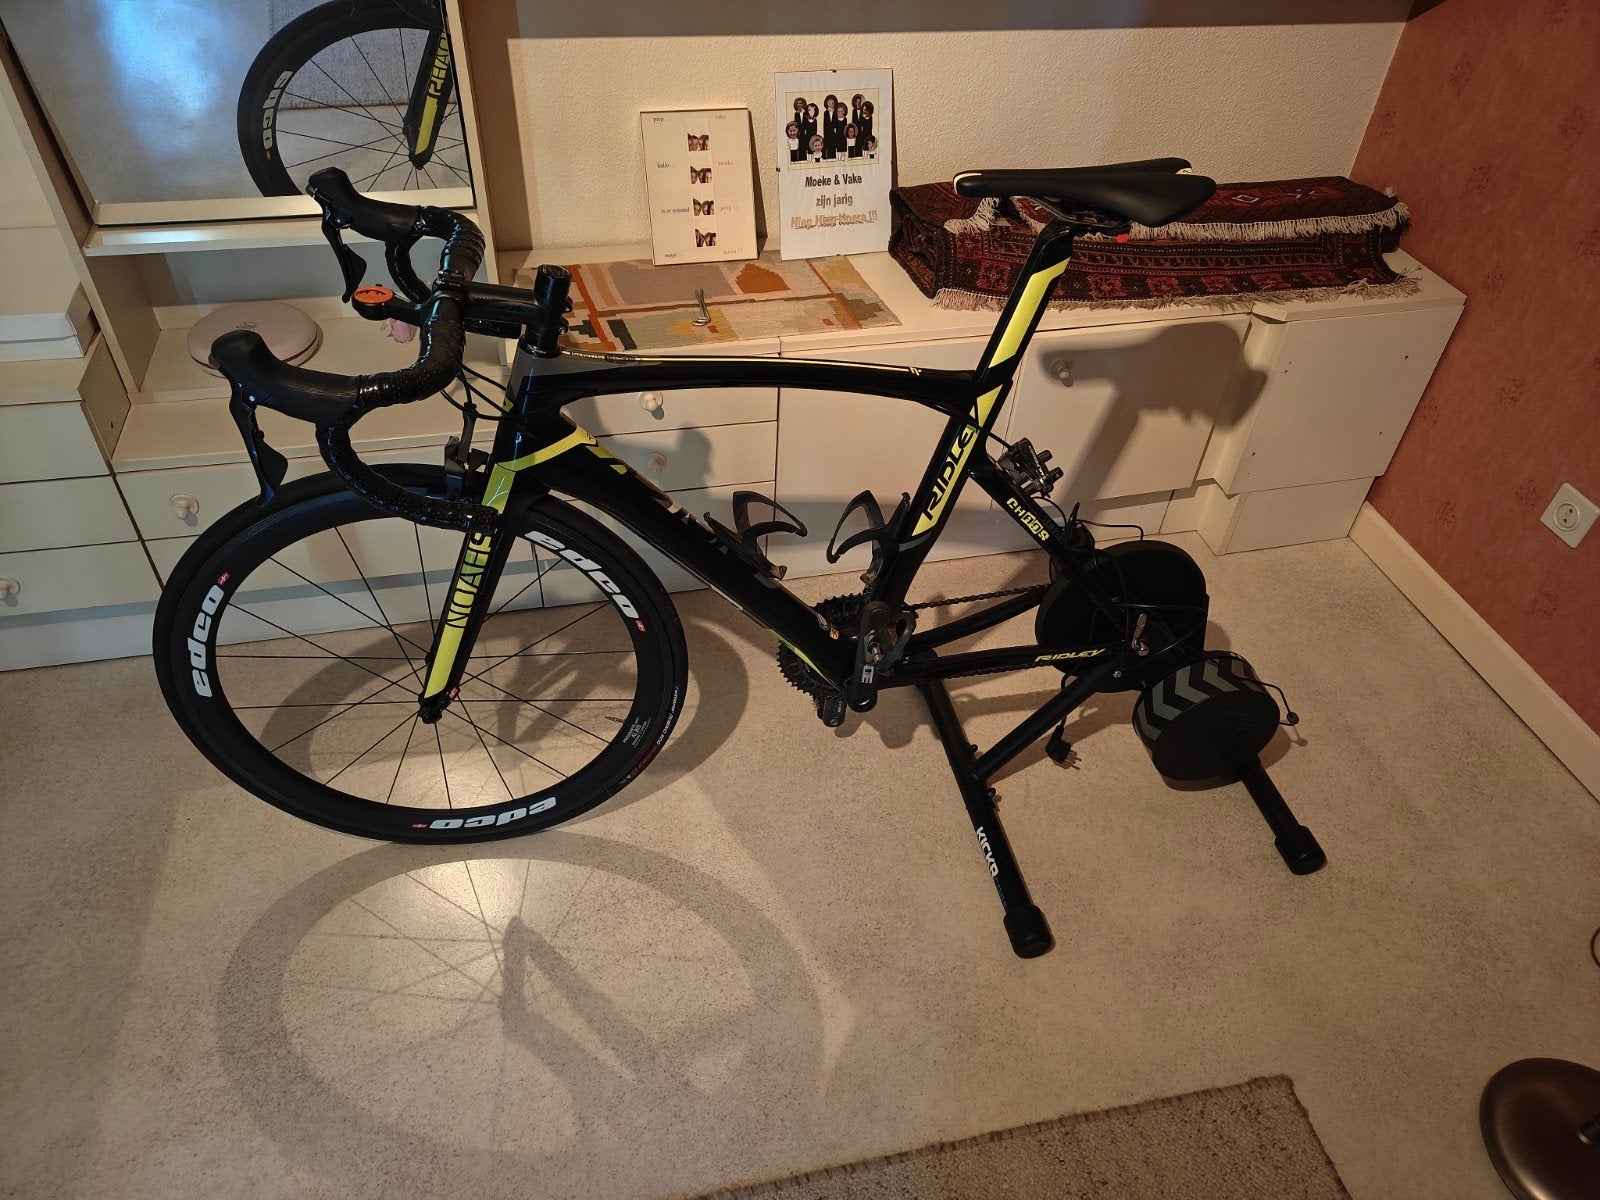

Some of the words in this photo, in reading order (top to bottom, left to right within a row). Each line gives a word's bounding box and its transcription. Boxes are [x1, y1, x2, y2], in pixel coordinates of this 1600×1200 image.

[805, 175, 832, 187] Moeke
[834, 174, 840, 185] &
[842, 173, 863, 185] Vake
[816, 194, 831, 209] zijn
[833, 193, 854, 208] jarig
[1006, 497, 1050, 541] CHAOS
[524, 530, 640, 619] edco
[187, 584, 225, 698] edco
[1034, 648, 1106, 663] RIDLEY
[429, 796, 557, 829] edco
